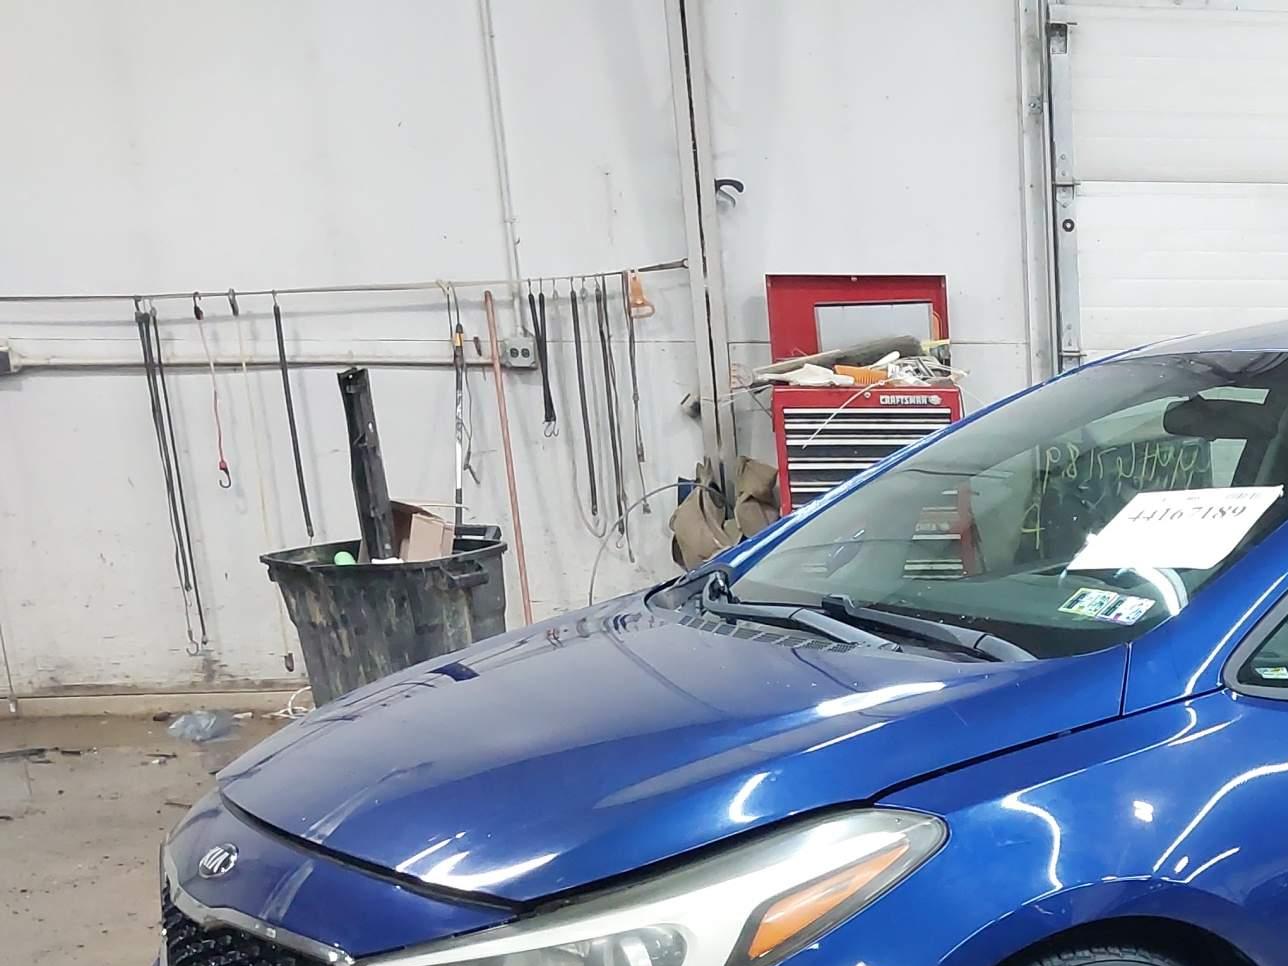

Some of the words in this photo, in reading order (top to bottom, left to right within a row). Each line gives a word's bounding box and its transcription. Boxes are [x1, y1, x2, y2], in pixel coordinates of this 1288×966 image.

[880, 394, 927, 405] CRAFTSMAN
[1128, 505, 1247, 523] 44167189
[199, 844, 238, 878] KIA
